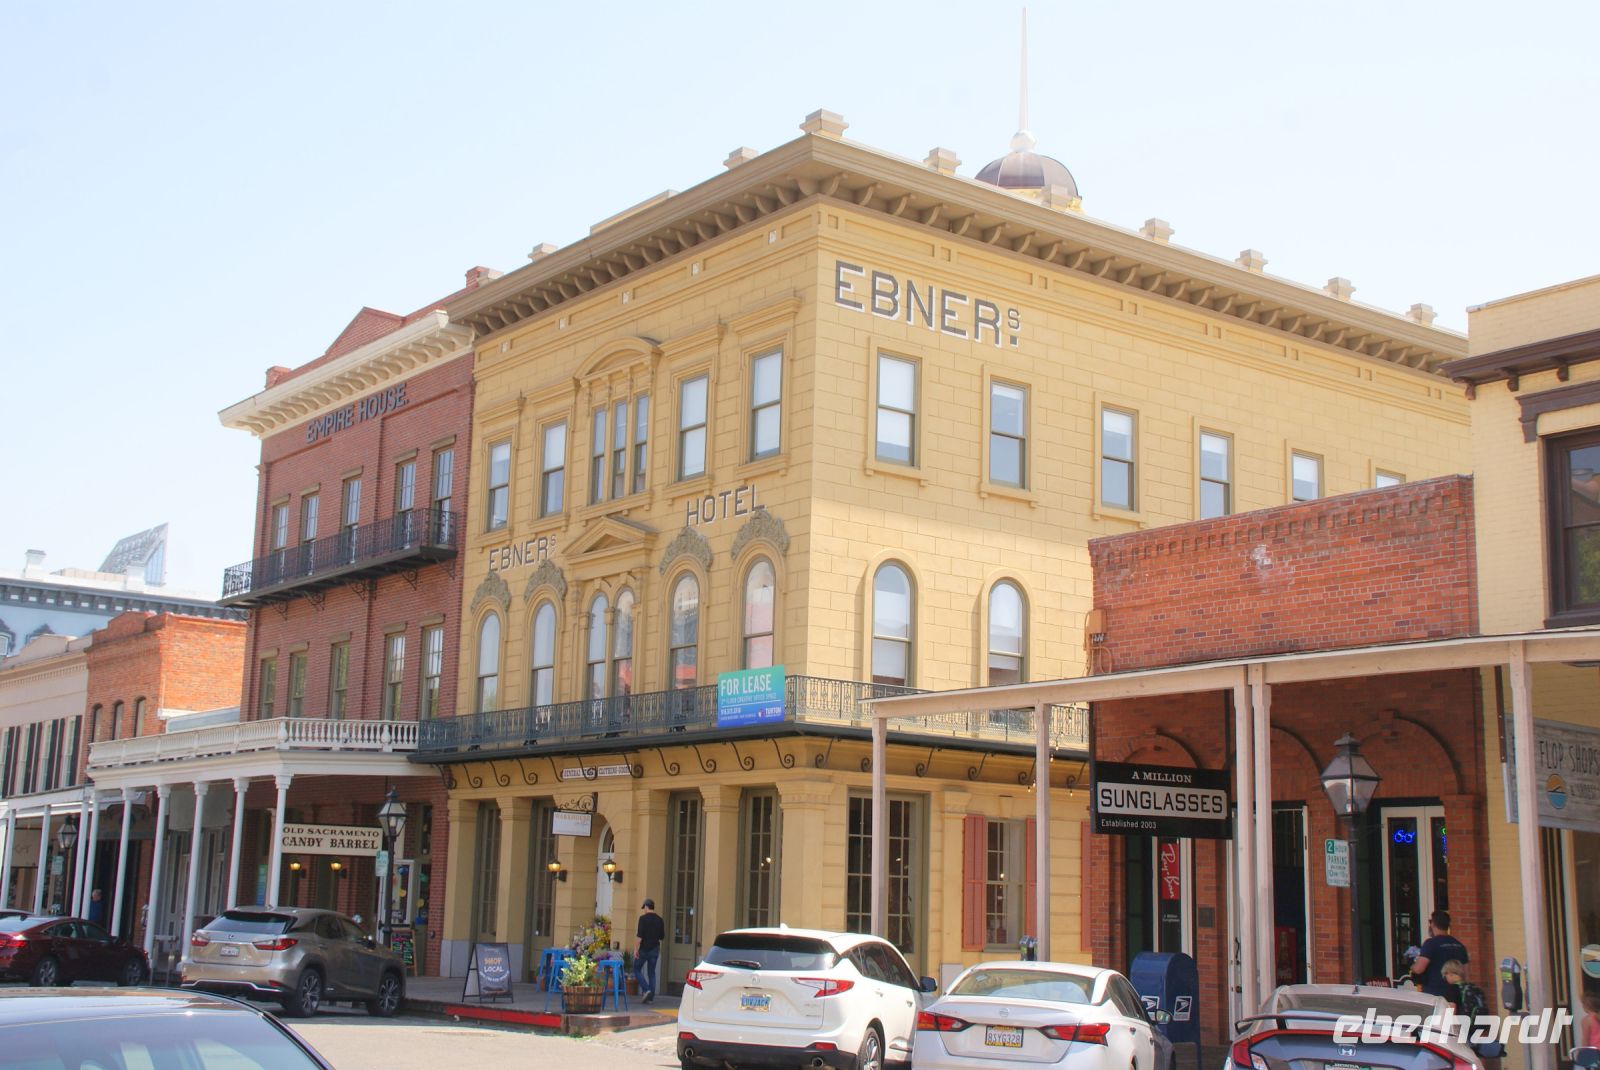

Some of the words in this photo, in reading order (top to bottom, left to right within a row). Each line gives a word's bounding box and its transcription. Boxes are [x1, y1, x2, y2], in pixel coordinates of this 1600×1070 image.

[305, 406, 355, 443] EMPIRE
[686, 483, 765, 528] HOTEL
[720, 678, 739, 697] FOR
[742, 673, 772, 694] LEASE
[1539, 740, 1563, 769] FLOP
[1131, 771, 1140, 780] A
[1142, 772, 1192, 783] MILLION
[1100, 788, 1223, 814] SUNGLASSES
[1101, 818, 1139, 828] Established
[1140, 820, 1157, 829] 2003
[283, 826, 304, 834] OLD
[307, 827, 380, 838] SACRAMENTO
[282, 836, 323, 848] CANDY
[329, 838, 379, 850] BARREL
[1327, 841, 1334, 852] 2
[1327, 854, 1348, 865] PARKING
